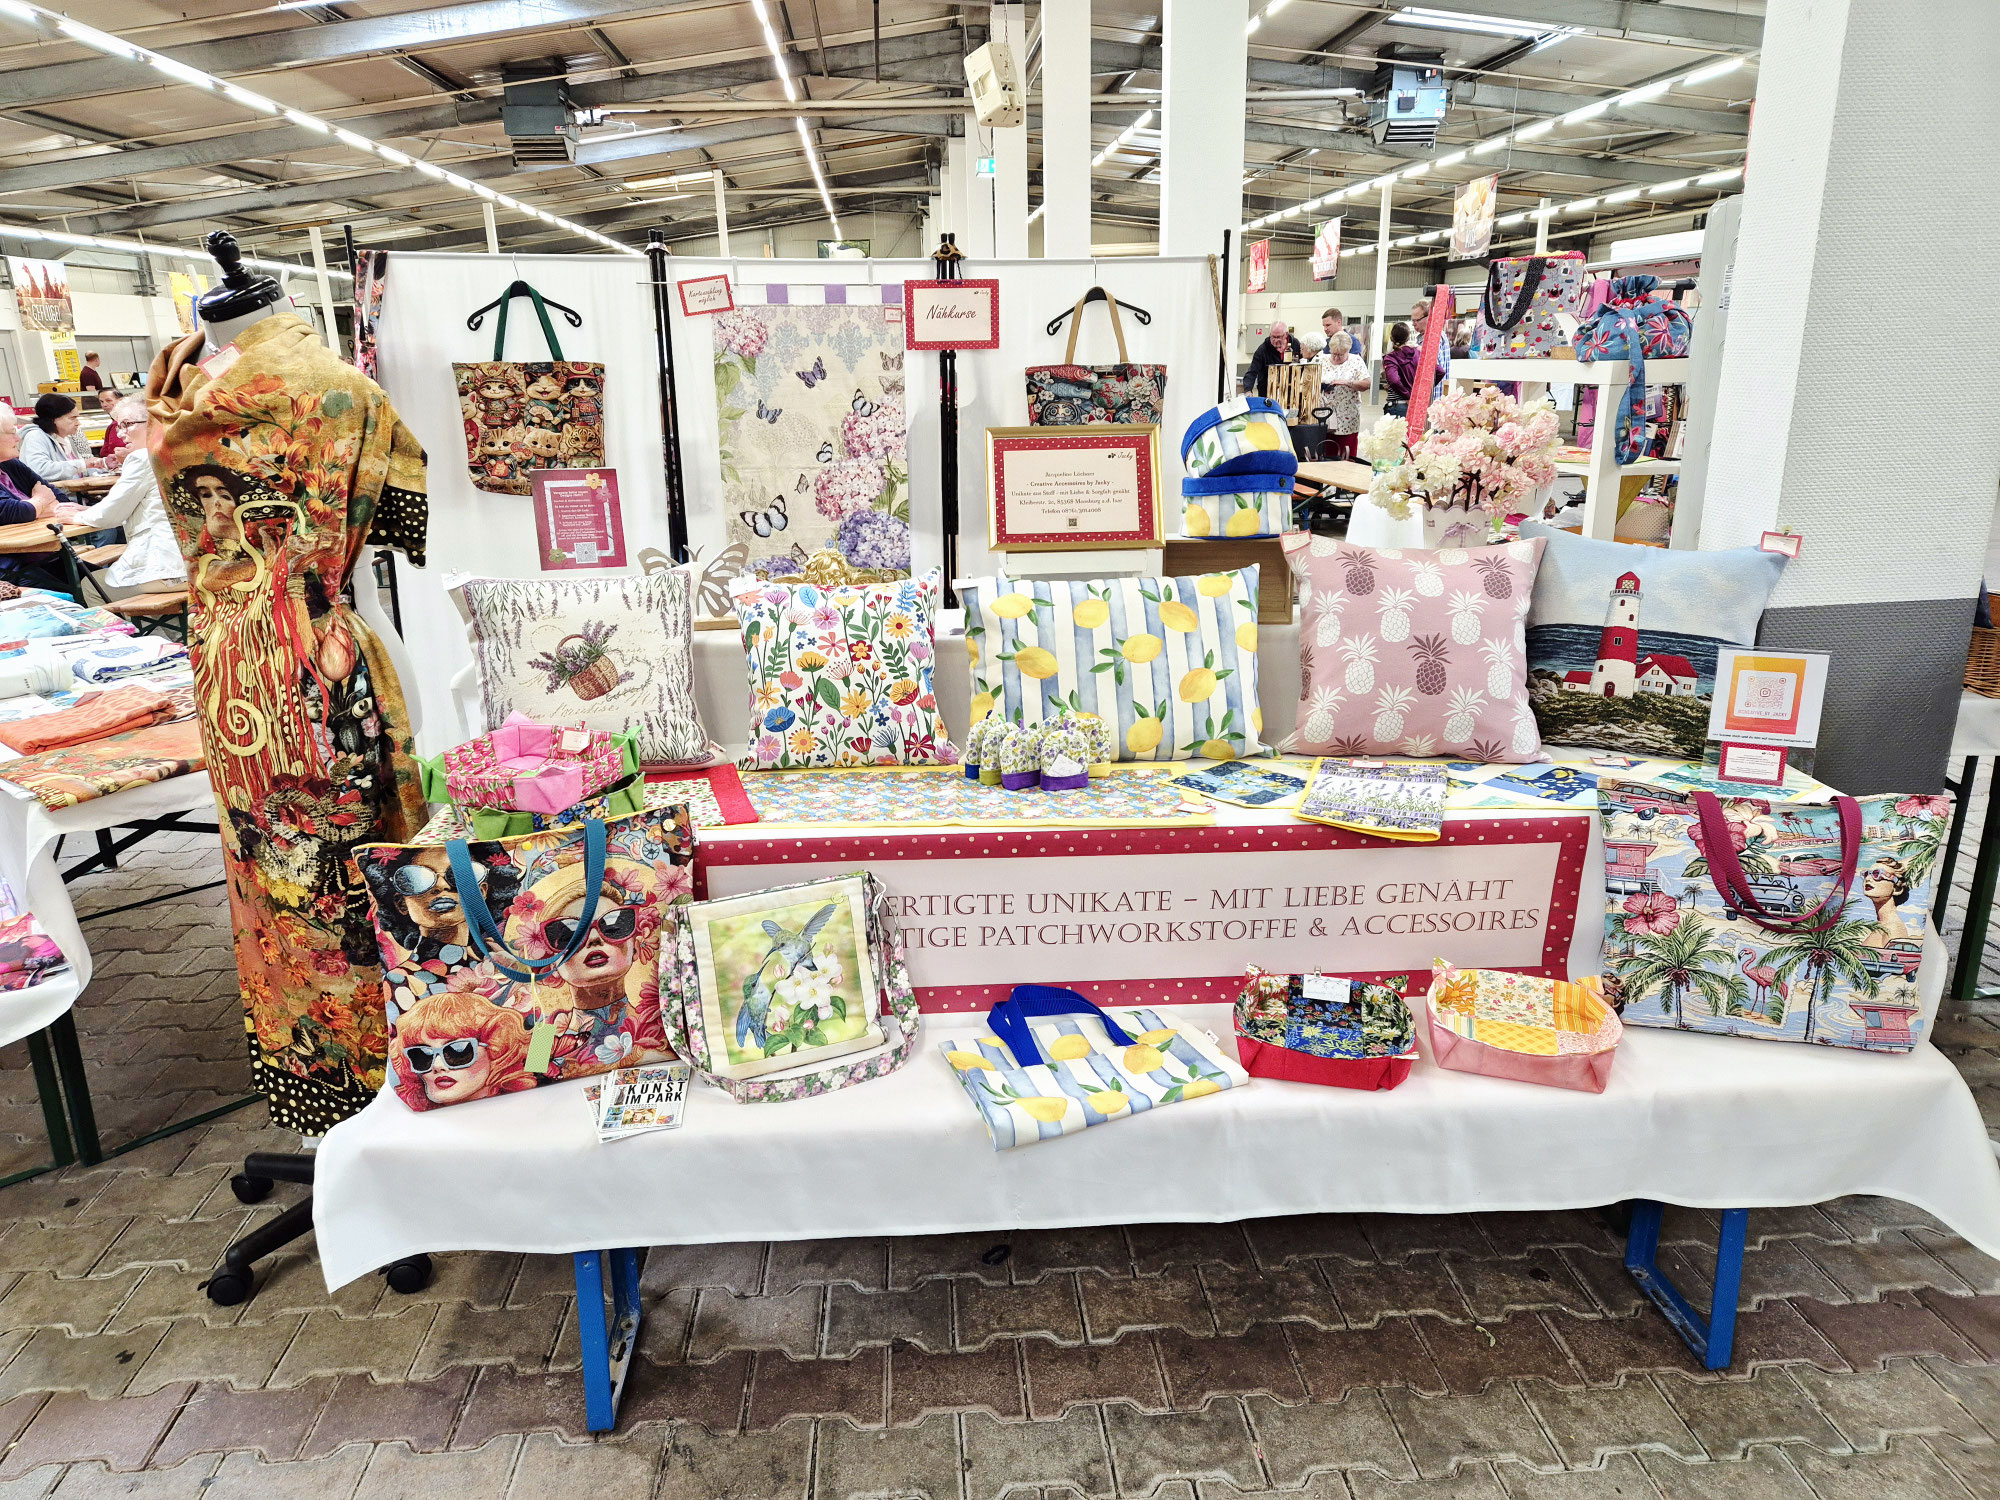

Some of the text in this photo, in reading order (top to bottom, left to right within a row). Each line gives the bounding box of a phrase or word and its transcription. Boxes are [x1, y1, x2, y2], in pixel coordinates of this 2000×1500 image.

[926, 304, 977, 320] Nähkurse
[1094, 479, 1110, 487] Jacky
[883, 893, 1015, 917] ERTIGTE
[1027, 890, 1172, 914] UNIKATE
[1209, 887, 1273, 910] MIT
[1283, 884, 1366, 908] LIEBE
[1376, 878, 1514, 904] GENÄHT
[978, 918, 1298, 947] PATCHWORKSTOFFE
[1308, 916, 1328, 938] &
[1341, 908, 1540, 937] ACCESSOIRES
[627, 1081, 686, 1095] KUNST
[625, 1091, 683, 1105] IM PARK
